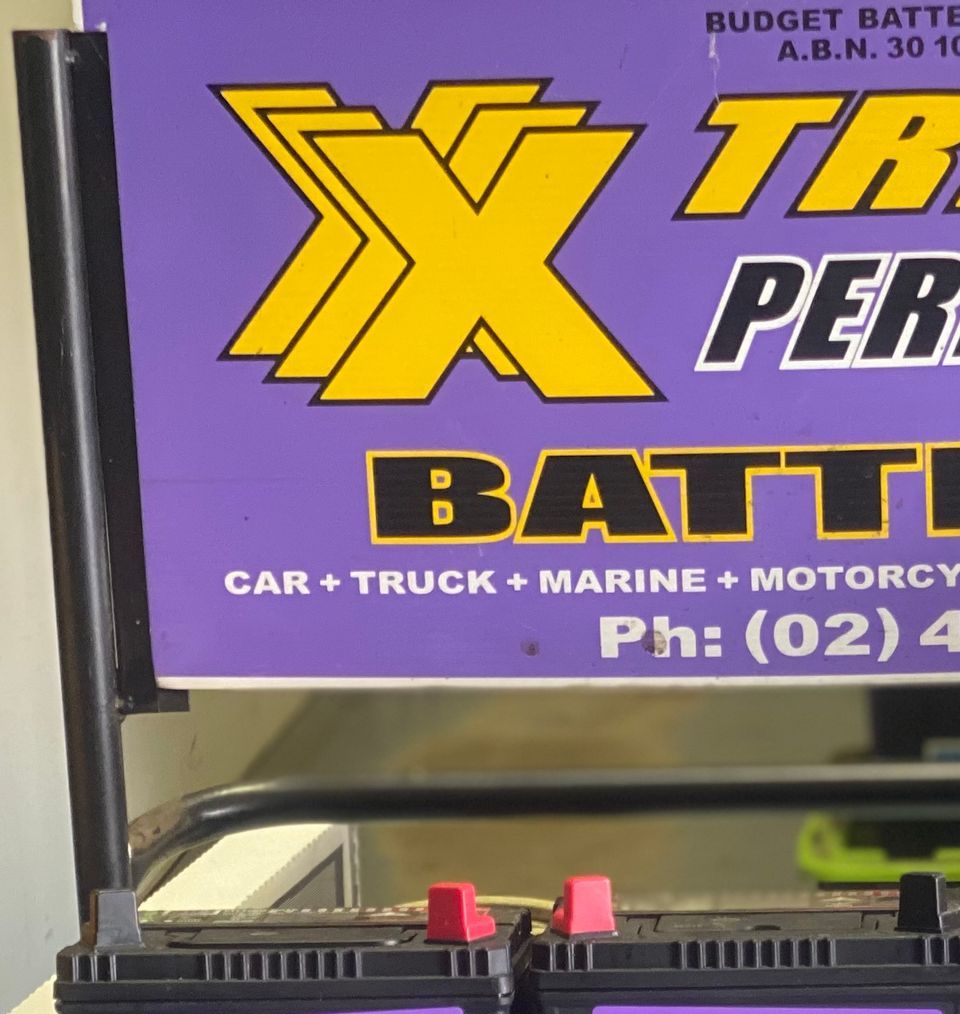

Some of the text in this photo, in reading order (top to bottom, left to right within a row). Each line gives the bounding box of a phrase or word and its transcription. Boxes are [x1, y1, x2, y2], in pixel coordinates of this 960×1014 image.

[705, 7, 843, 34] BUDGET
[777, 38, 878, 63] A.B.N.
[887, 36, 925, 60] 30
[224, 570, 311, 596] CAR
[350, 569, 497, 596] TRUCK
[539, 567, 707, 595] MARINE
[599, 614, 723, 660] Ph:
[745, 607, 900, 664] (02)
